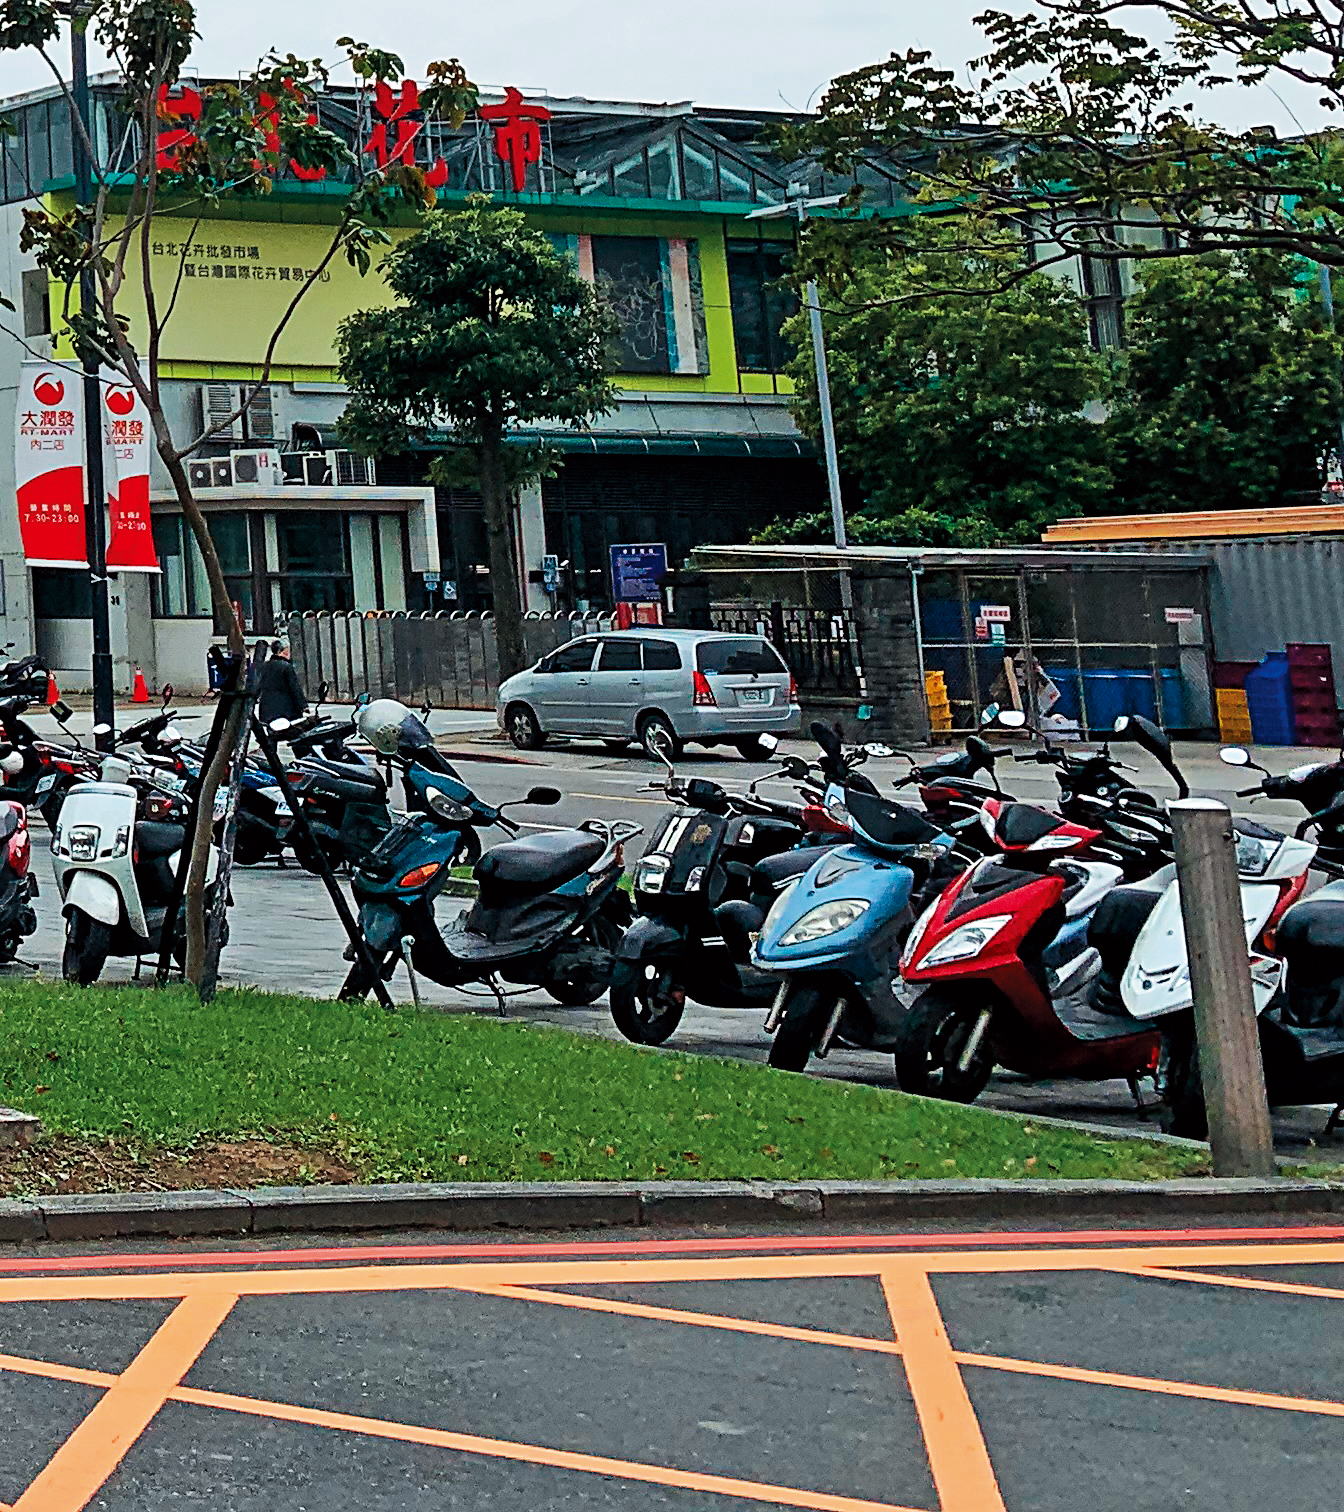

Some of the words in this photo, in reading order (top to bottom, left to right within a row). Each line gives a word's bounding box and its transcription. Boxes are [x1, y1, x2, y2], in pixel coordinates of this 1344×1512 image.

[21, 410, 75, 427] 大潤發
[20, 428, 75, 436] RT-MART
